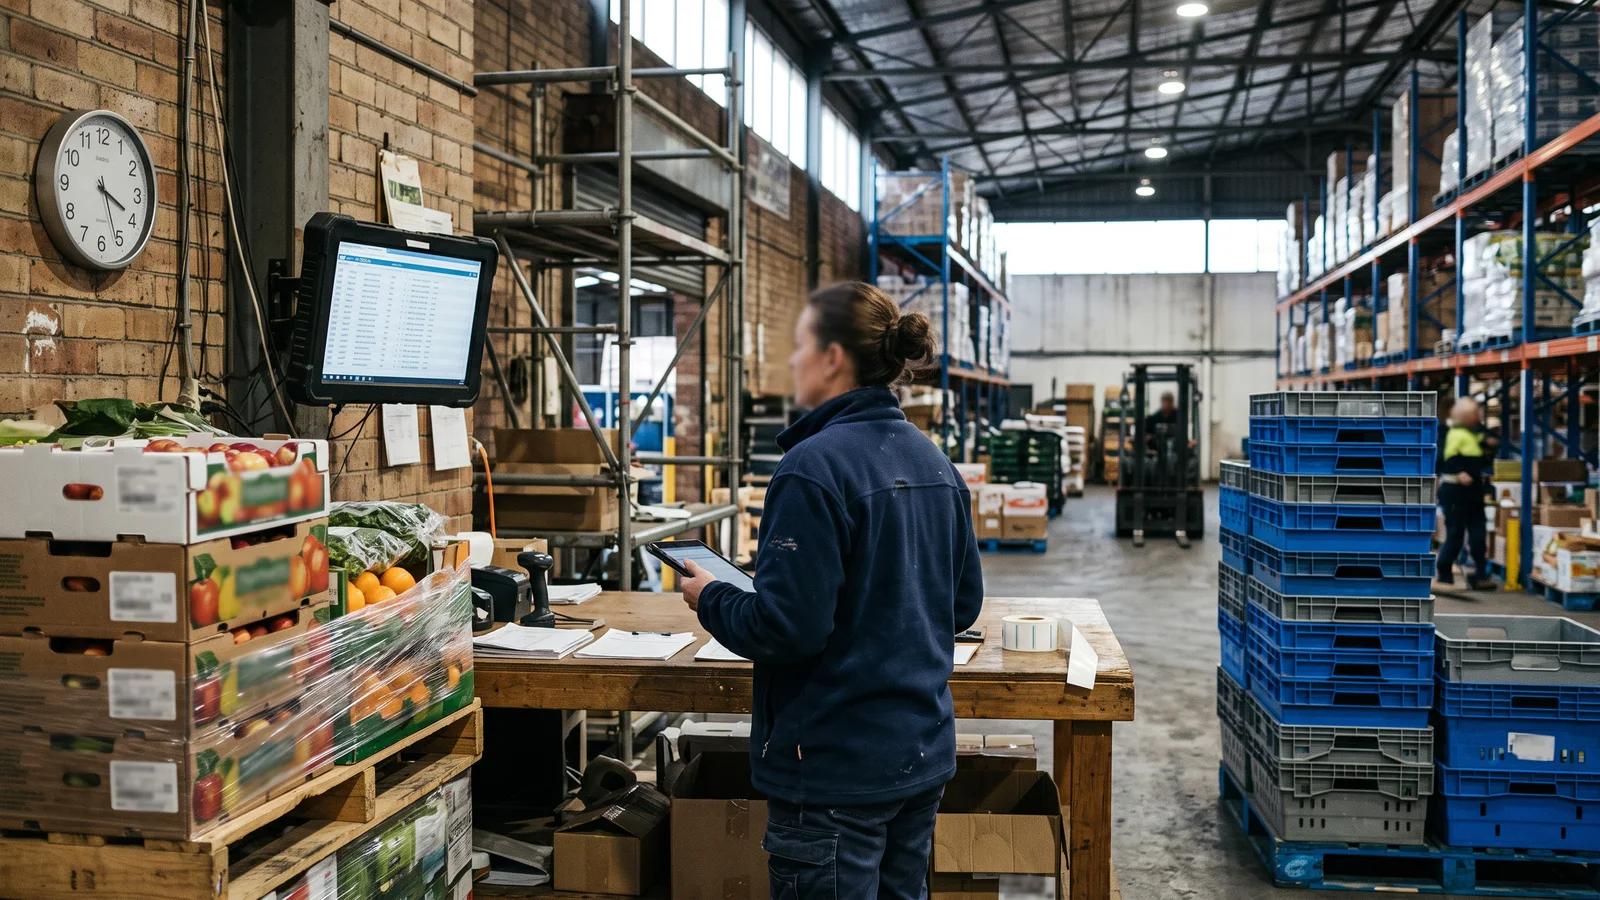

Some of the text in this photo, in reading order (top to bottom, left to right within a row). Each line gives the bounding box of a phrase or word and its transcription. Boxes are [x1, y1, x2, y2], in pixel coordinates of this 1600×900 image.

[79, 131, 91, 149] 11
[96, 127, 110, 146] 12
[117, 139, 123, 155] 1
[65, 148, 80, 167] 10
[128, 160, 137, 177] 2
[60, 173, 69, 191] 9
[133, 188, 142, 204] 3
[65, 202, 75, 220] 8
[128, 213, 136, 228] 4
[80, 225, 88, 242] 7
[115, 230, 124, 247] 5
[97, 235, 106, 252] 6
